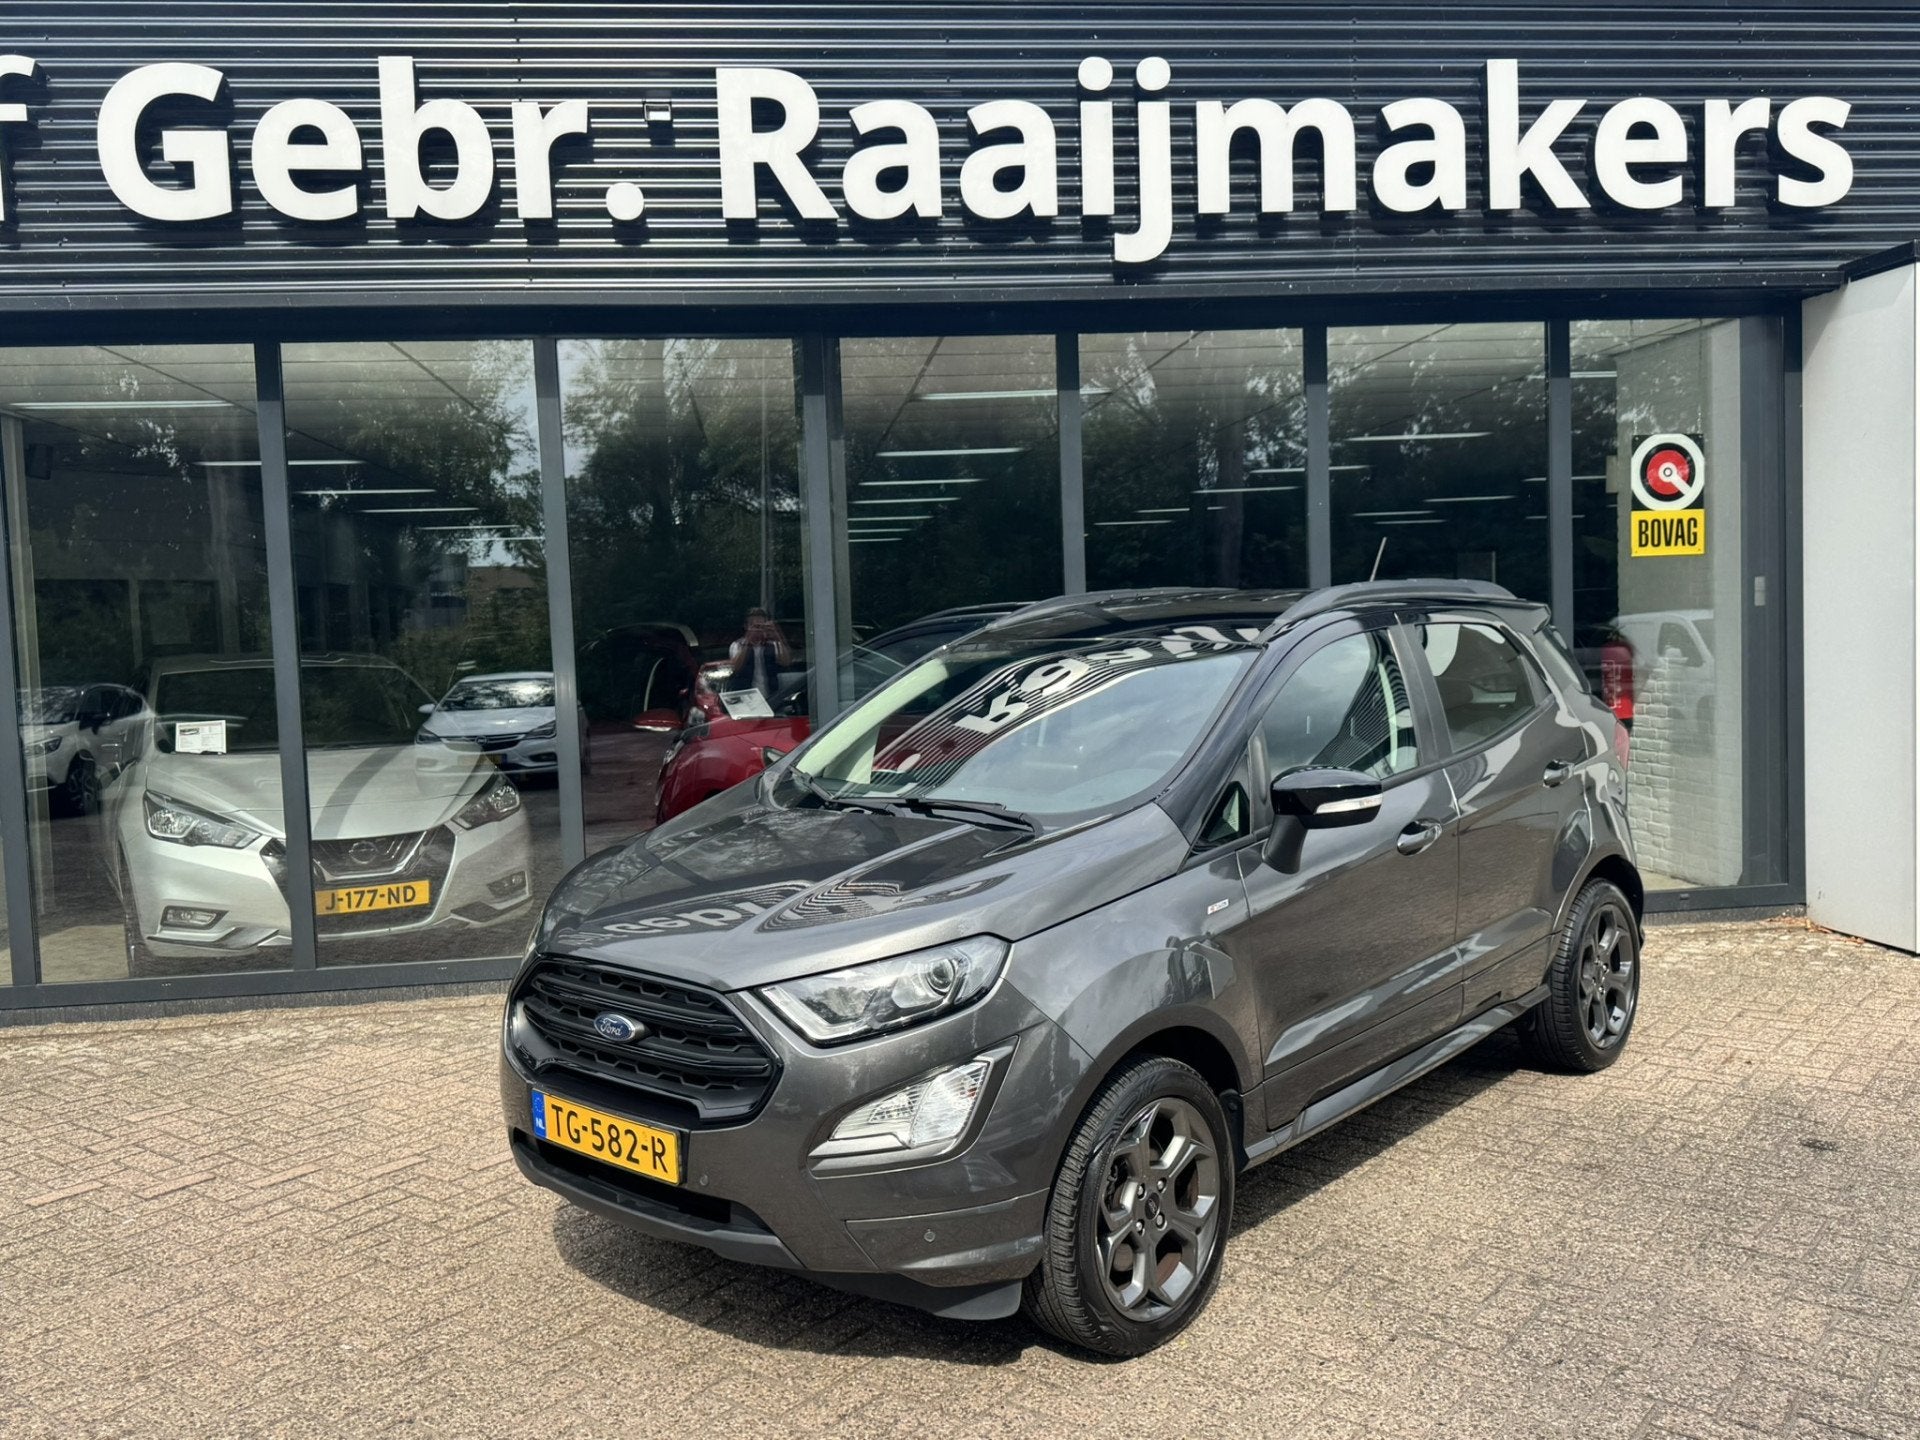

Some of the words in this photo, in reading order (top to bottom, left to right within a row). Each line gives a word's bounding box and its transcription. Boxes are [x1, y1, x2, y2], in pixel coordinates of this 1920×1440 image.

[97, 56, 645, 221] Gebr.
[716, 57, 1853, 262] Raaijmakers
[1638, 518, 1698, 548] BOVAG
[325, 885, 416, 911] J-177-ND
[600, 1017, 624, 1036] Ford
[551, 1103, 668, 1174] TG-582-R
